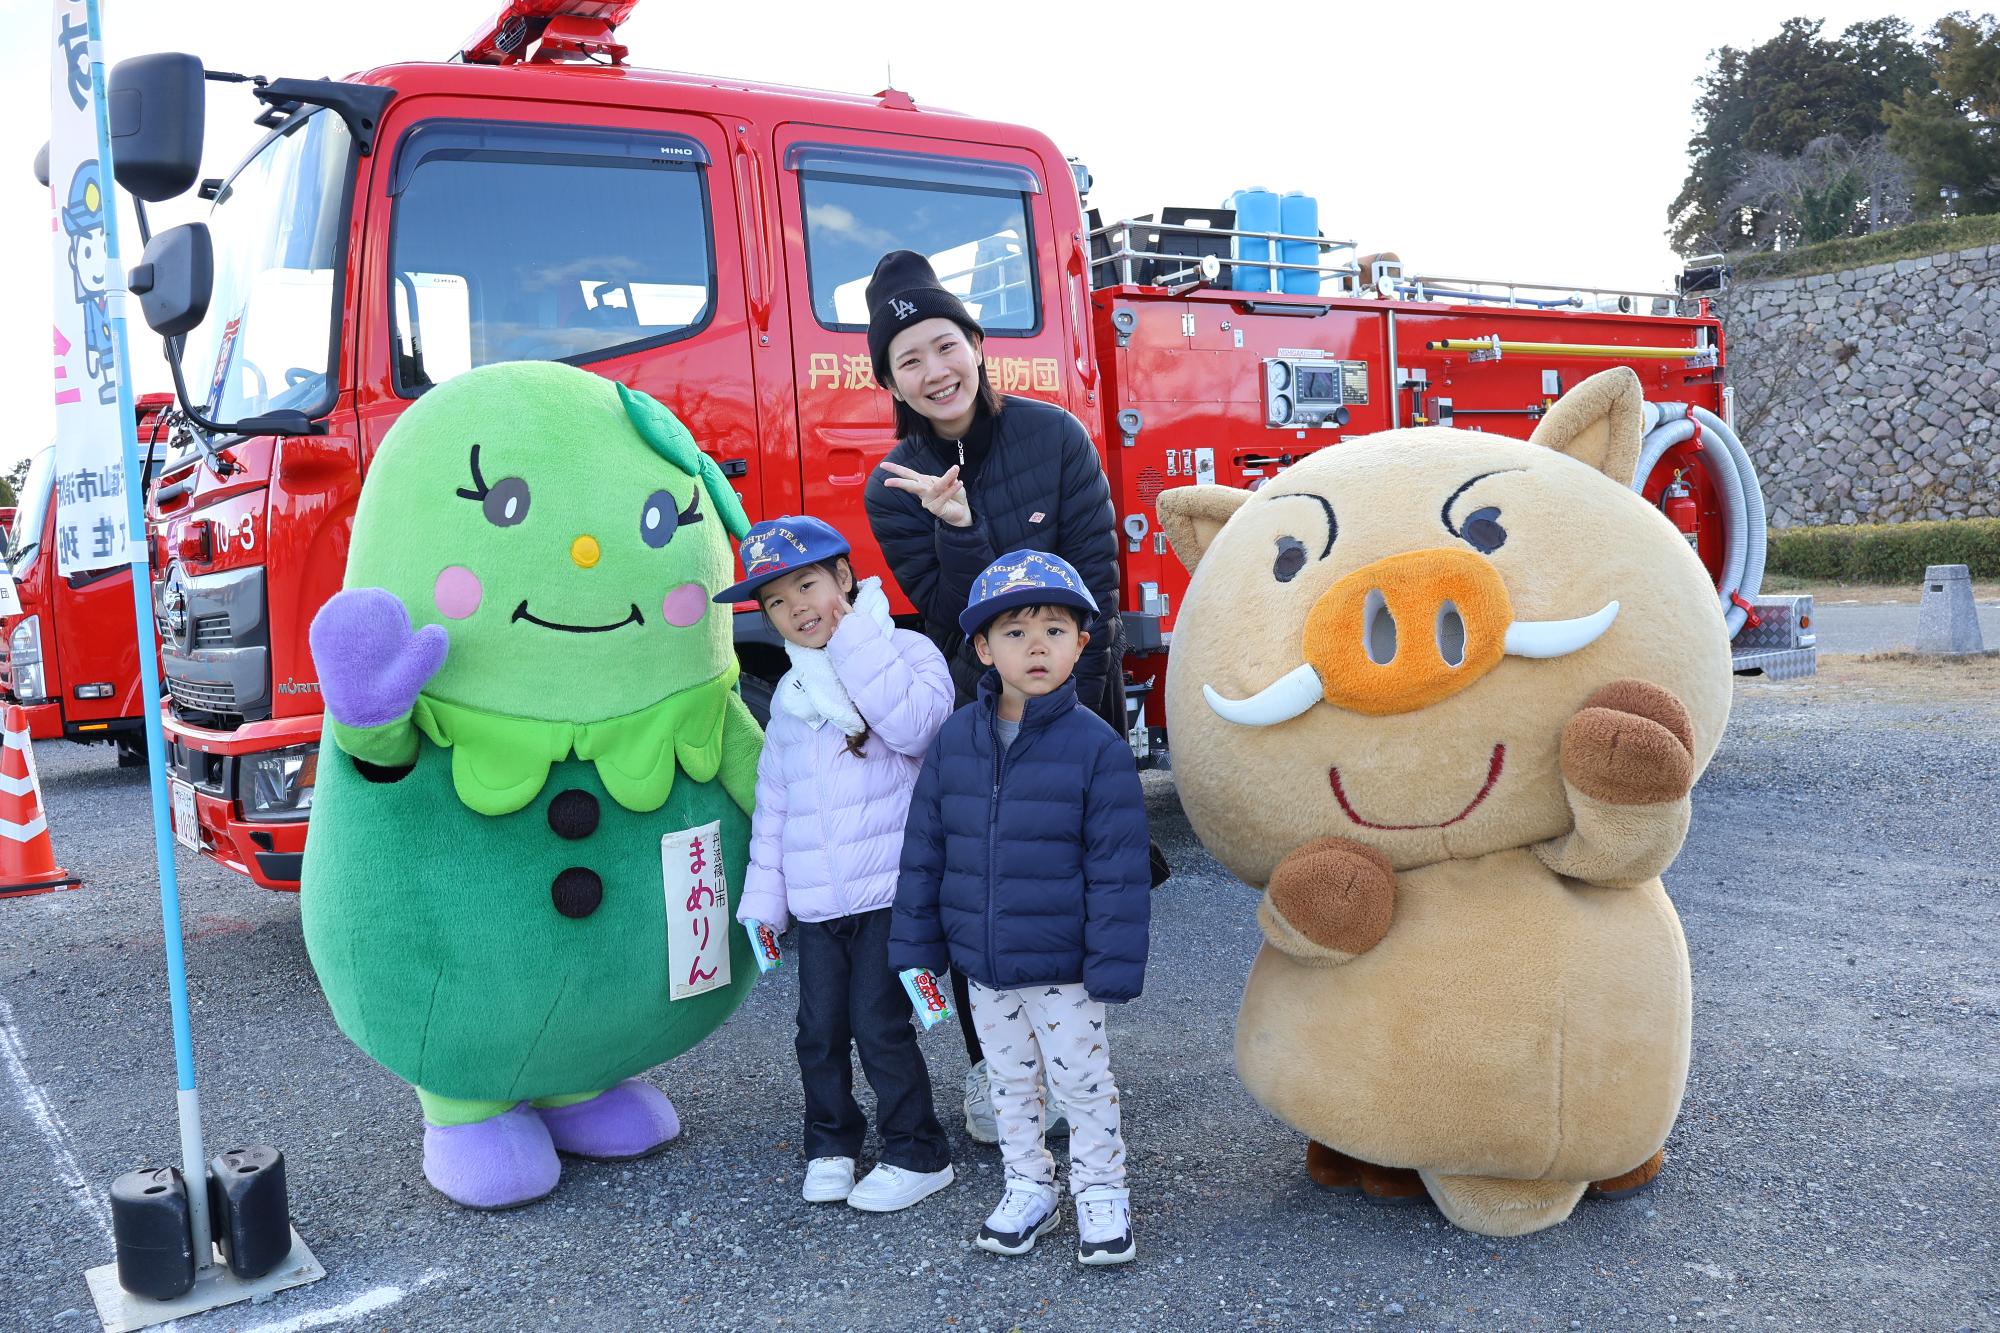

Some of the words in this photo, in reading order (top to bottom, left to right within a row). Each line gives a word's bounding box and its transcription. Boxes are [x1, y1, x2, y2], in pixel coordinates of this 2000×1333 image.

[661, 147, 693, 156] HINO
[888, 298, 918, 320] LA
[214, 512, 255, 553] 10-3
[778, 528, 808, 554] TEAM
[985, 554, 1043, 577] FIGHTING
[1044, 562, 1075, 589] TEAM
[686, 836, 718, 985] まめりん
